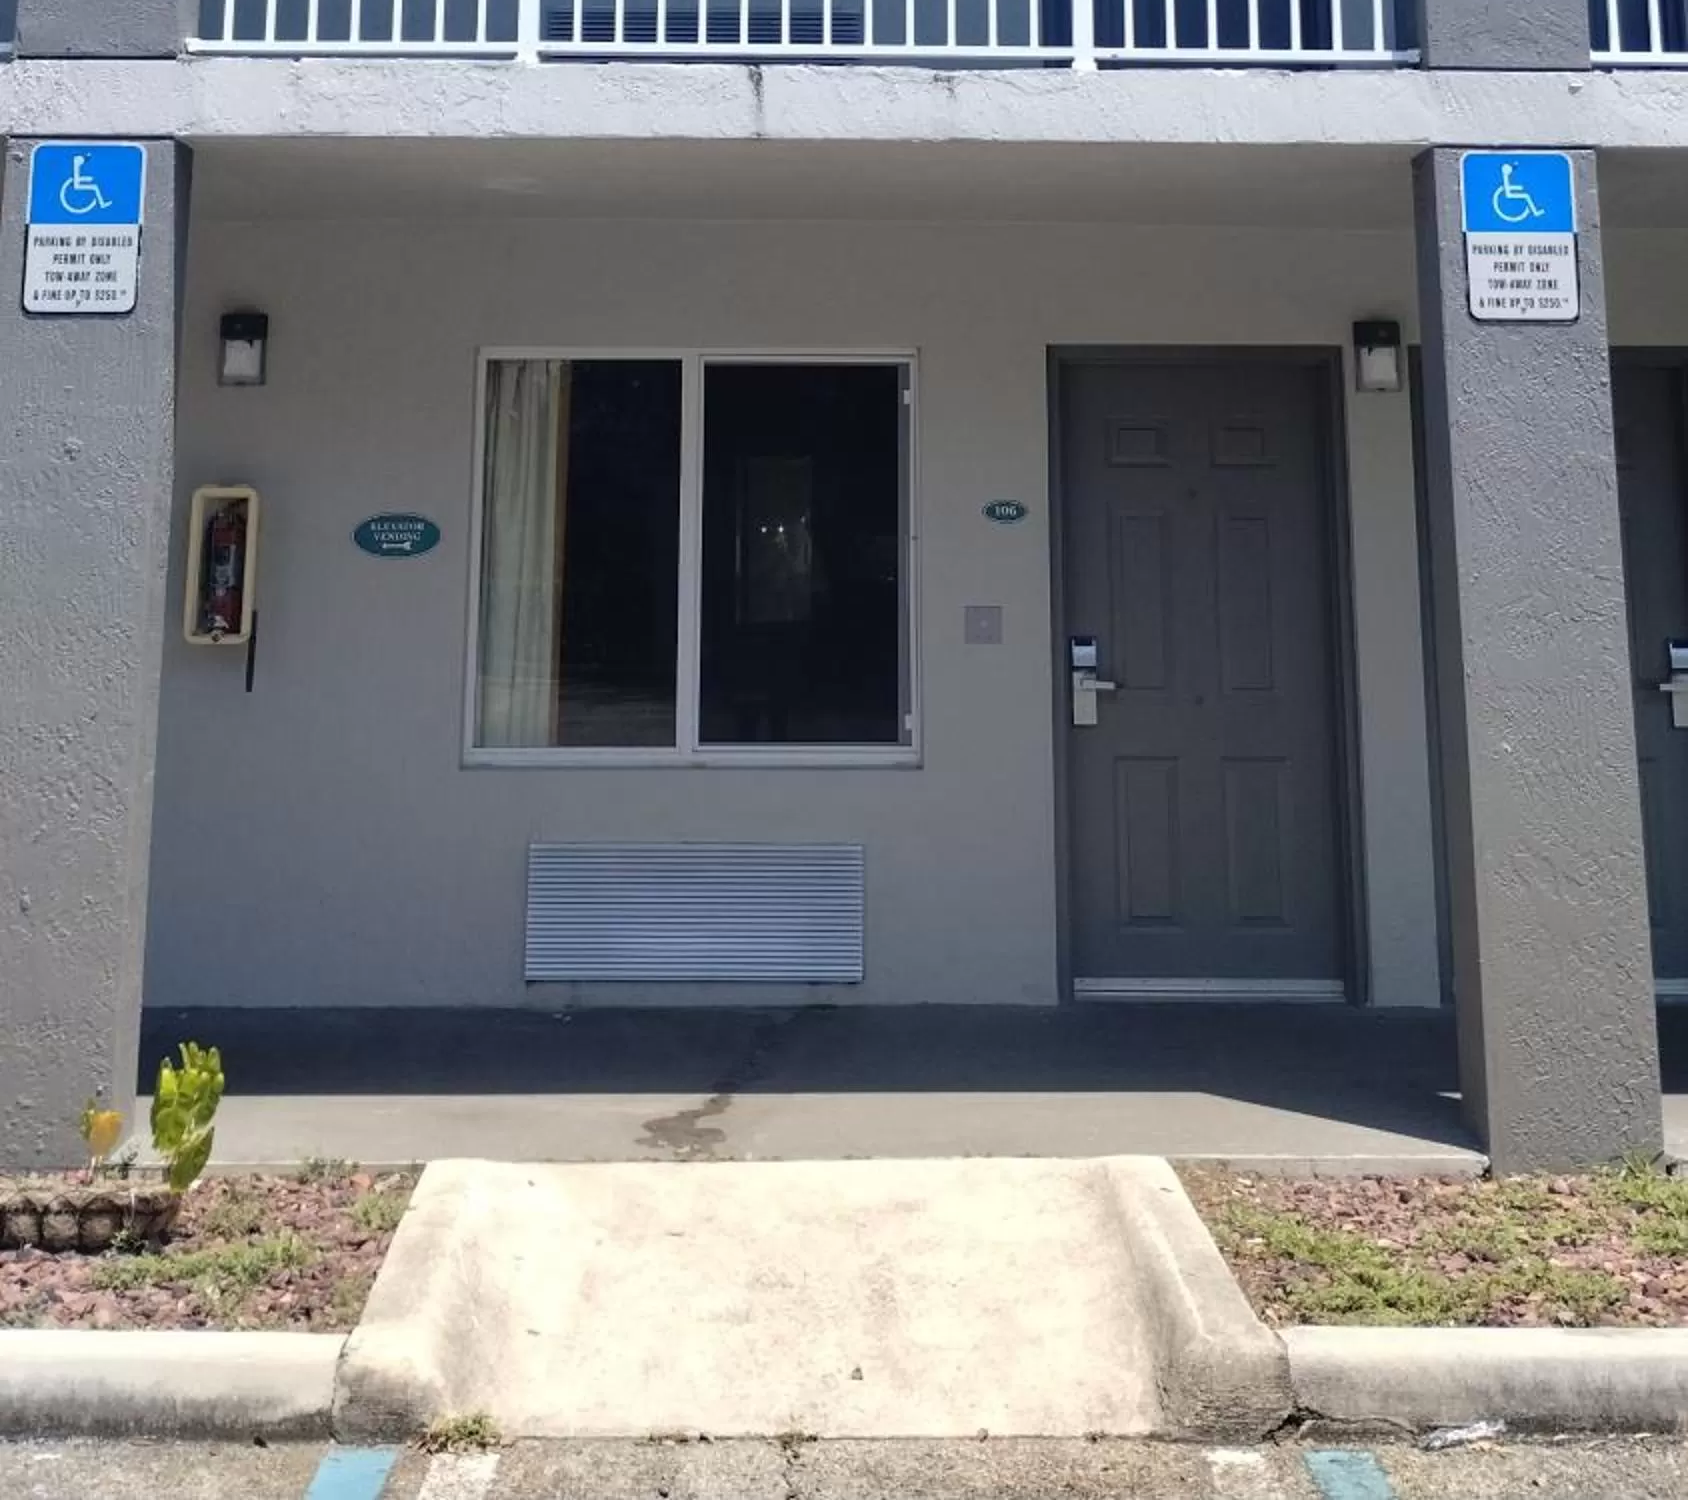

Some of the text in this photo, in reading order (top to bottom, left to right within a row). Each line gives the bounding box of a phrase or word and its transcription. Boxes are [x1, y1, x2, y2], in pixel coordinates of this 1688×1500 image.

[33, 236, 133, 247] PARKING BY DISABLED
[1472, 244, 1569, 255] PARKING BY DISABLED
[53, 253, 112, 265] PERMIT ONLY
[1493, 261, 1550, 273] PERMIT ONLY
[95, 271, 117, 283] ZONE
[1537, 279, 1559, 290] ZONE
[42, 289, 62, 301] FINE
[64, 289, 77, 301] UP
[80, 289, 91, 301] TO
[1487, 297, 1506, 308] FINE
[1509, 297, 1521, 308] UP
[1523, 297, 1535, 309] TO
[995, 505, 1017, 516] 106
